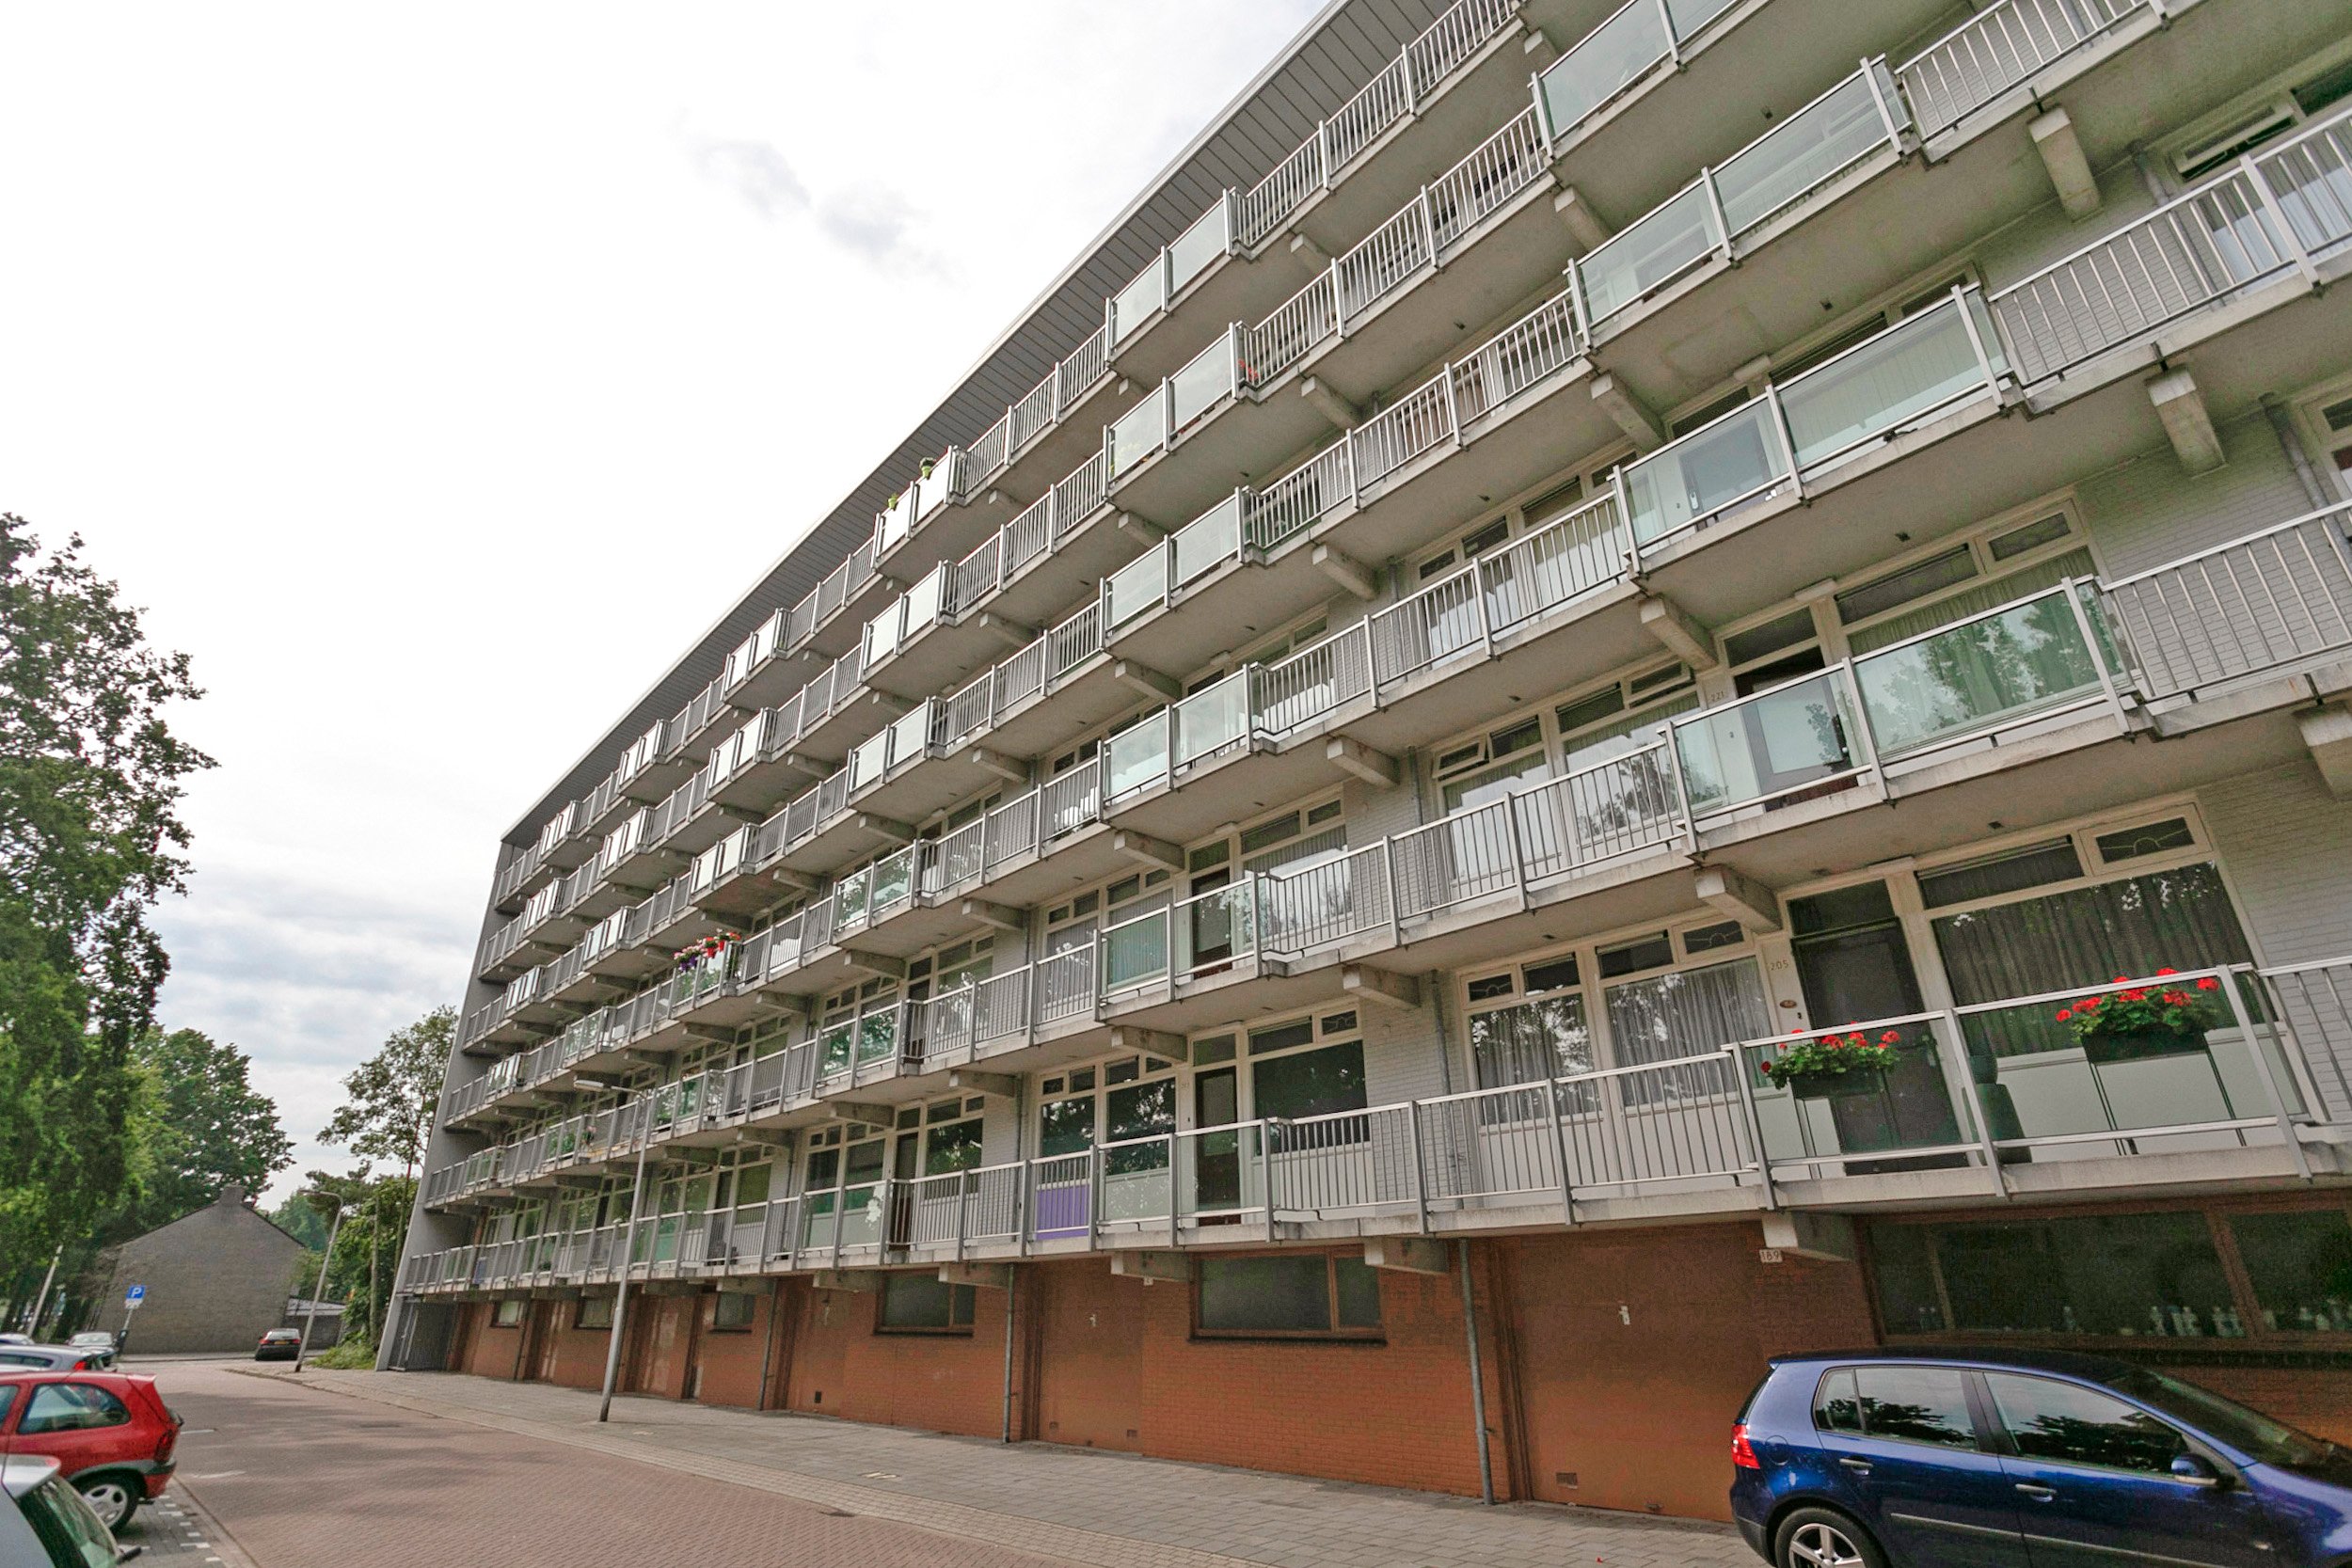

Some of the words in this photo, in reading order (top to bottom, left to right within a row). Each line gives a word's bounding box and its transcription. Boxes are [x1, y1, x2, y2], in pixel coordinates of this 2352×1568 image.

[1770, 959, 1789, 971] 205
[1760, 1250, 1780, 1261] 189
[131, 1287, 142, 1298] P
